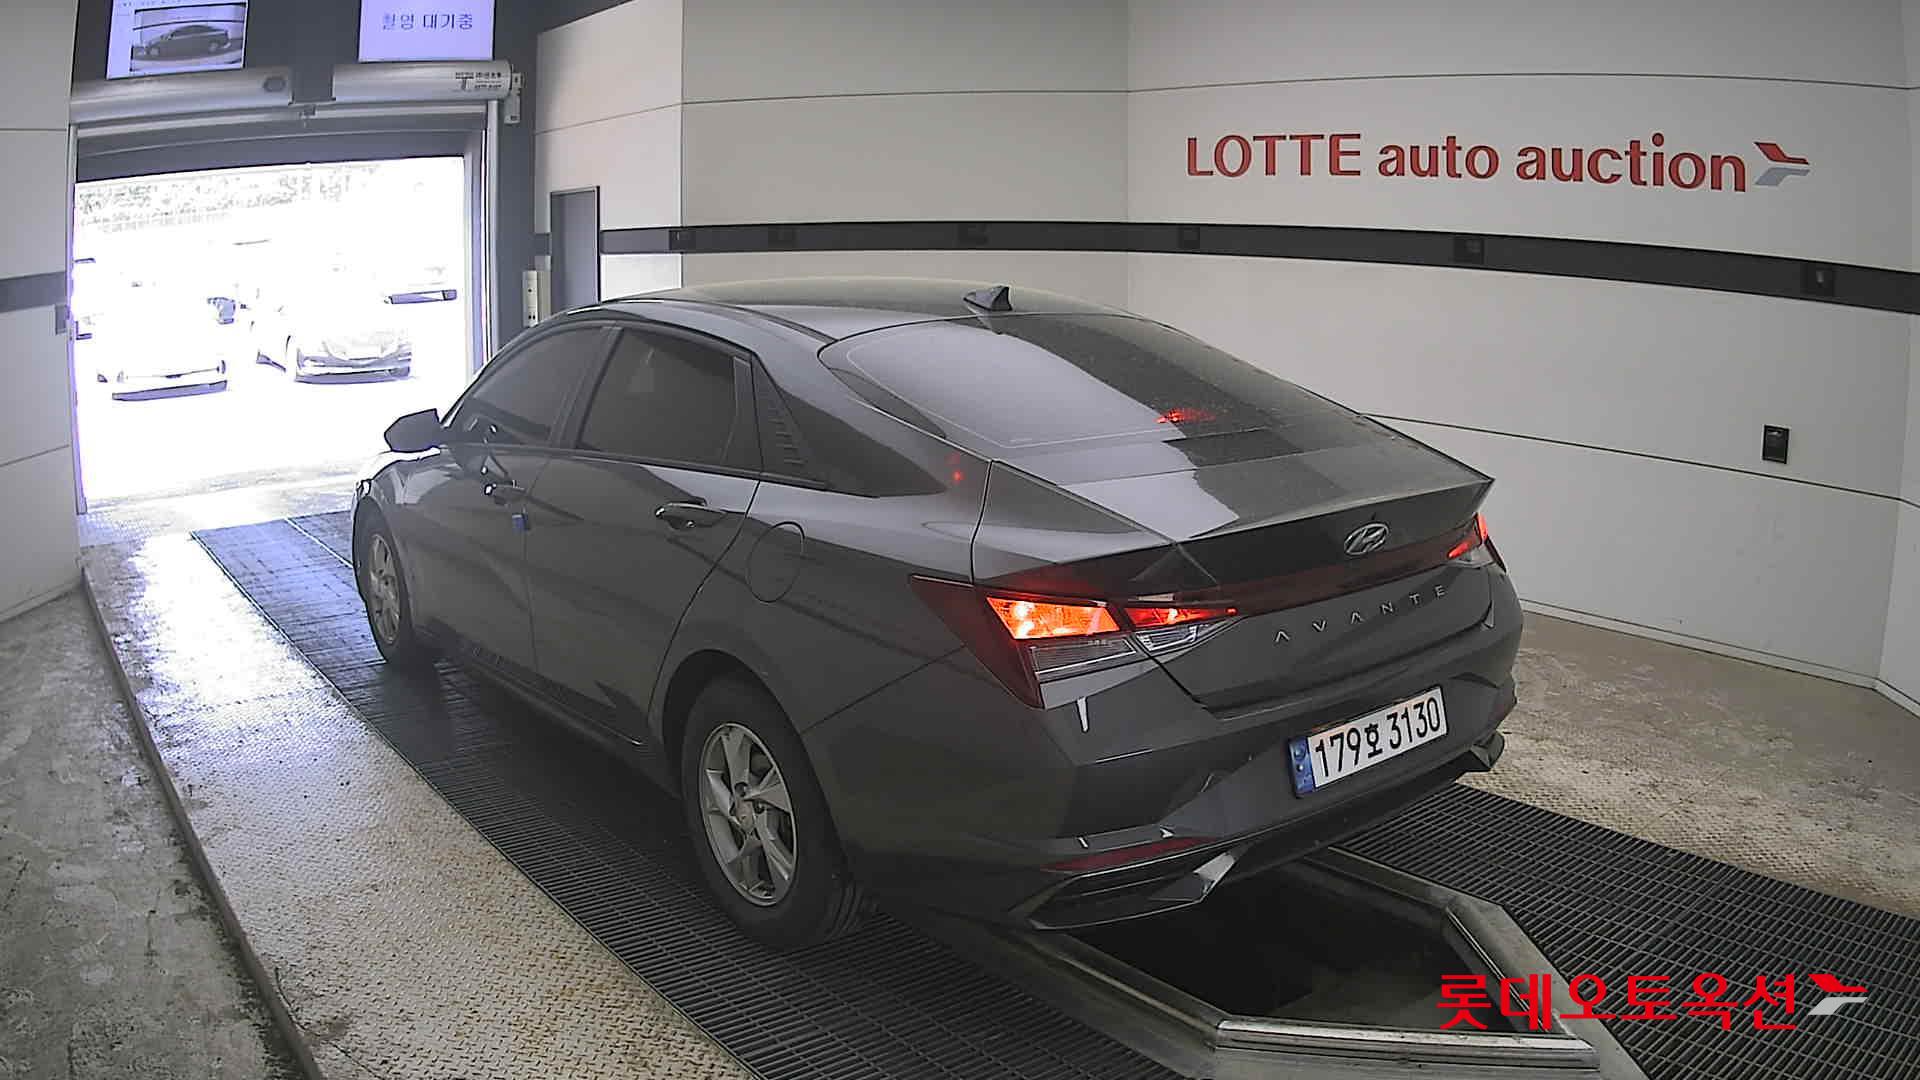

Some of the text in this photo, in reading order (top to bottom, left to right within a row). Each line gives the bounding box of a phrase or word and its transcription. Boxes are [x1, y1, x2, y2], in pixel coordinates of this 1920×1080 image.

[423, 13, 473, 31] 대기중
[1187, 132, 1745, 192] LOTTE auto auction
[1273, 585, 1448, 643] AVANTE
[1315, 697, 1441, 778] 179호 3130
